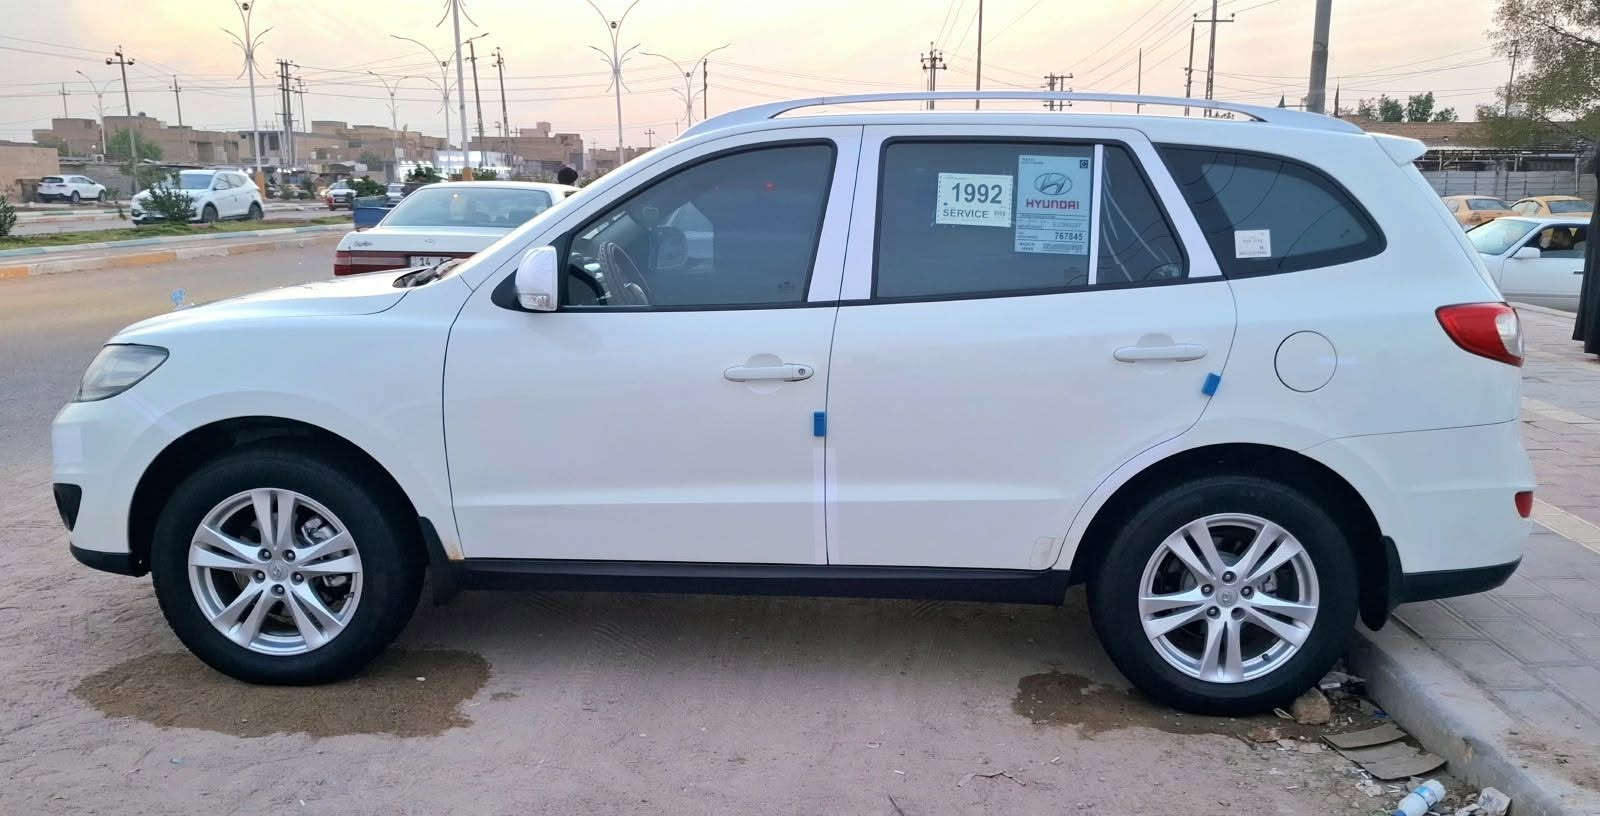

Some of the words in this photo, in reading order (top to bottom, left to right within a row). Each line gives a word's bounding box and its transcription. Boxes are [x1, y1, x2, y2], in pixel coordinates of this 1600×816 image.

[952, 183, 1002, 204] 1992
[1026, 199, 1080, 210] HYUNDAI
[943, 208, 990, 219] SERVICE
